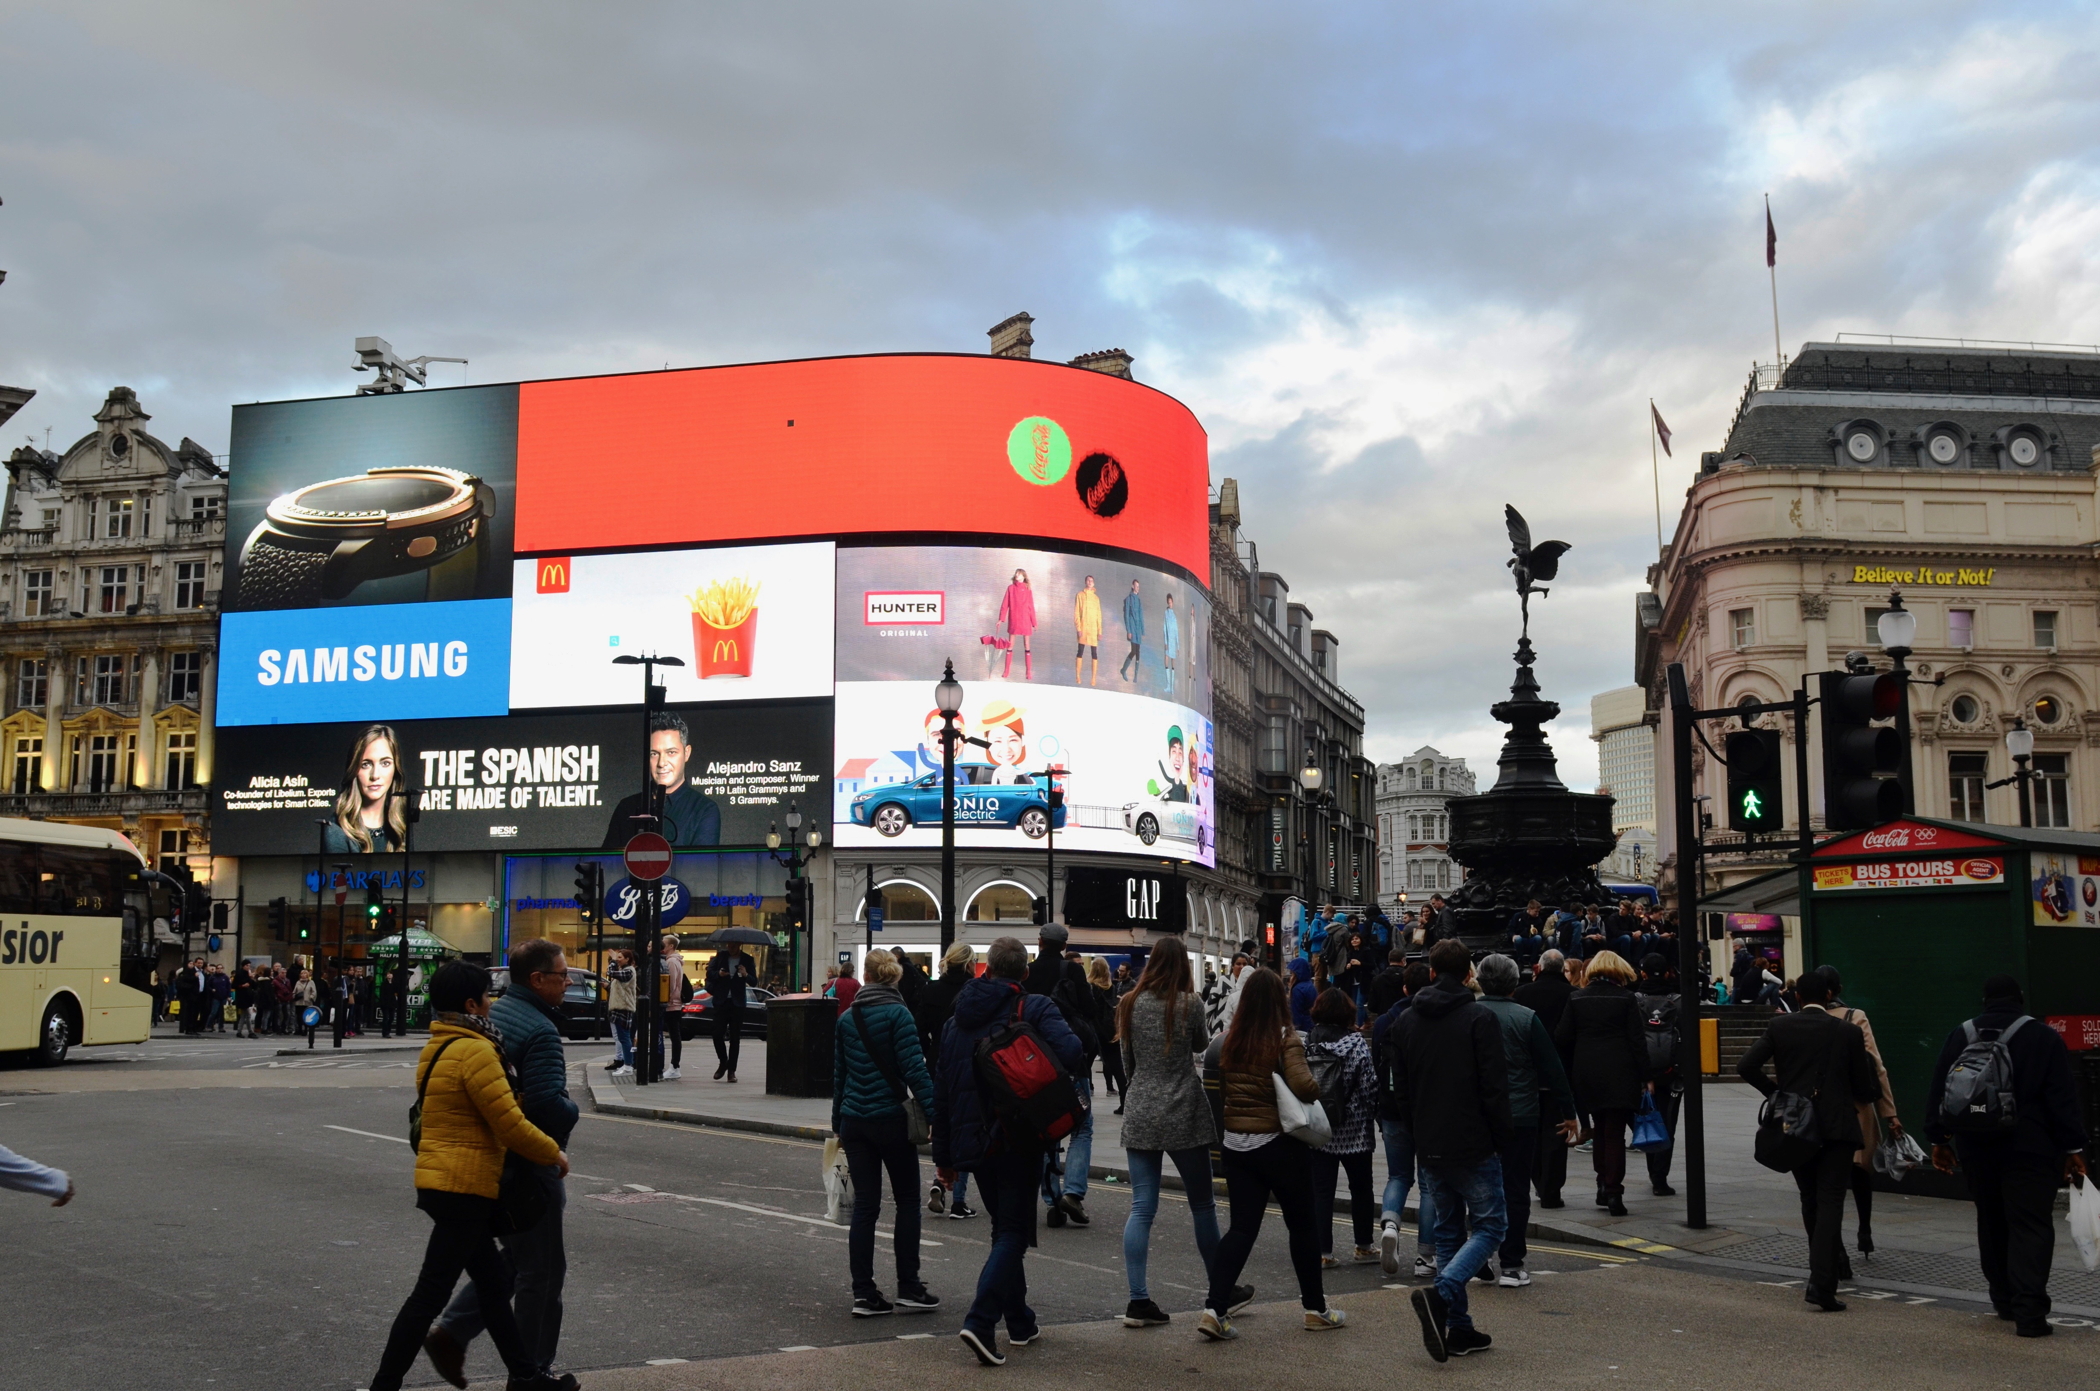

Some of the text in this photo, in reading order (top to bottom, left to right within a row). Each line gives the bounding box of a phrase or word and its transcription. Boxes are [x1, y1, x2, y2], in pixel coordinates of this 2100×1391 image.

[1853, 566, 1994, 585] Believe It or Not!
[871, 603, 937, 613] HUNTER
[257, 640, 468, 686] SAMSUNG
[420, 745, 600, 786] THE SPANISH
[706, 760, 801, 776] Alejandro Sanz
[249, 775, 308, 788] Alicia Asín
[691, 774, 820, 785] Musician and composer. Winner
[223, 790, 264, 799] Co-founder
[264, 789, 273, 798] of
[307, 788, 336, 798] Exports
[704, 783, 806, 795] of 19 Latin Grammys and
[227, 799, 331, 811] technologies for Smart Cities.
[419, 785, 602, 810] ARE MADE OF TALENT.
[729, 795, 779, 805] 3 Grammys.
[954, 808, 996, 820] electric
[1862, 828, 1911, 849] Coca-Cola
[1818, 868, 1849, 878] TICKETS
[1857, 860, 1955, 879] BUS TOURS
[1824, 877, 1844, 886] HERE
[516, 895, 583, 912] pharmac
[612, 883, 679, 920] Bts
[709, 893, 764, 909] beauty
[1127, 877, 1161, 920] GAP
